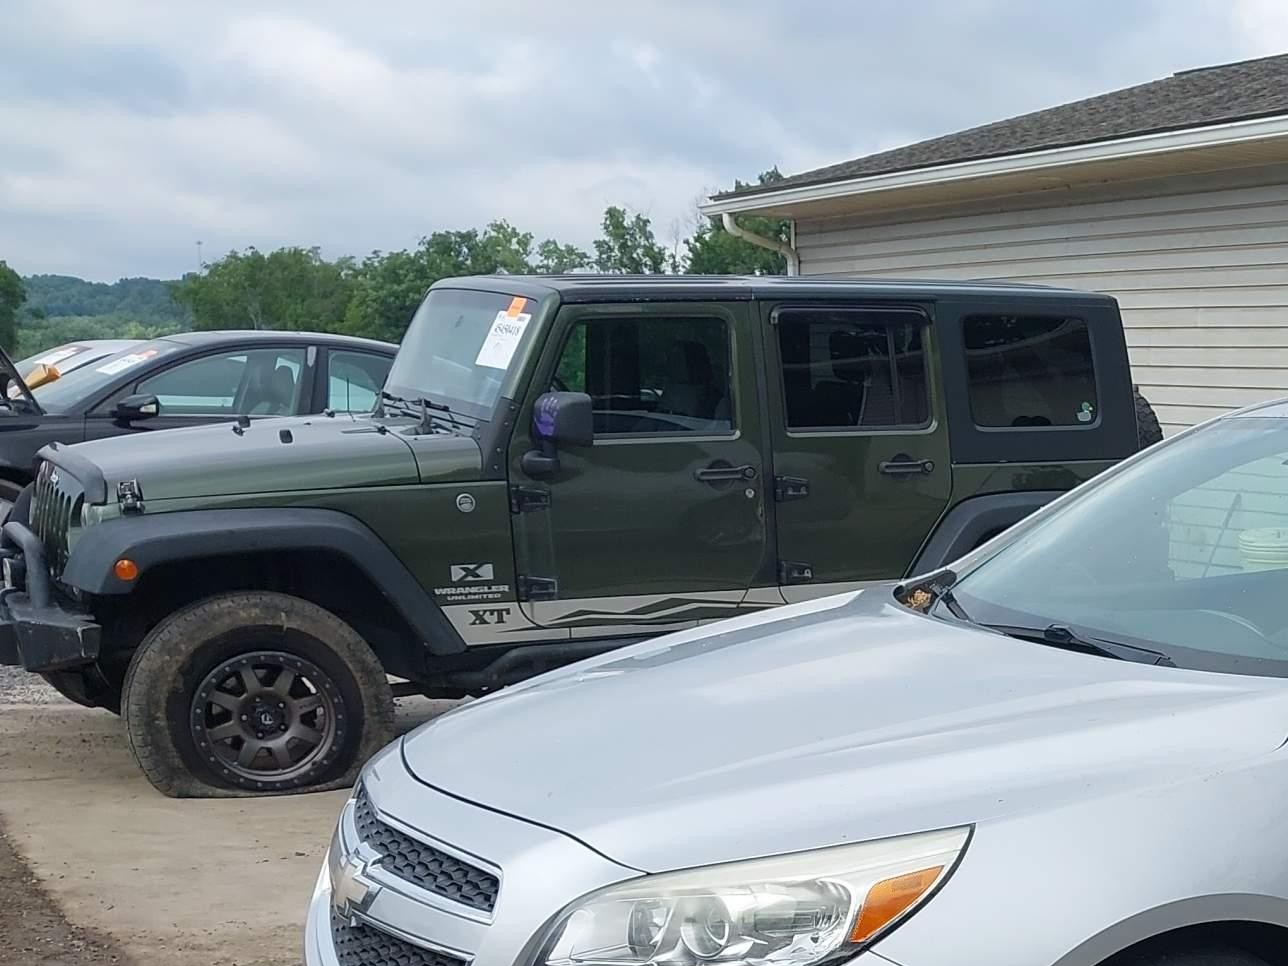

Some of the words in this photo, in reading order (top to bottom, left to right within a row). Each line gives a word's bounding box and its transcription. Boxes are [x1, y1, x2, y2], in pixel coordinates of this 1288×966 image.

[434, 585, 510, 595] WRANGLER
[447, 593, 502, 601] UNLIMITED
[468, 608, 511, 625] XT
